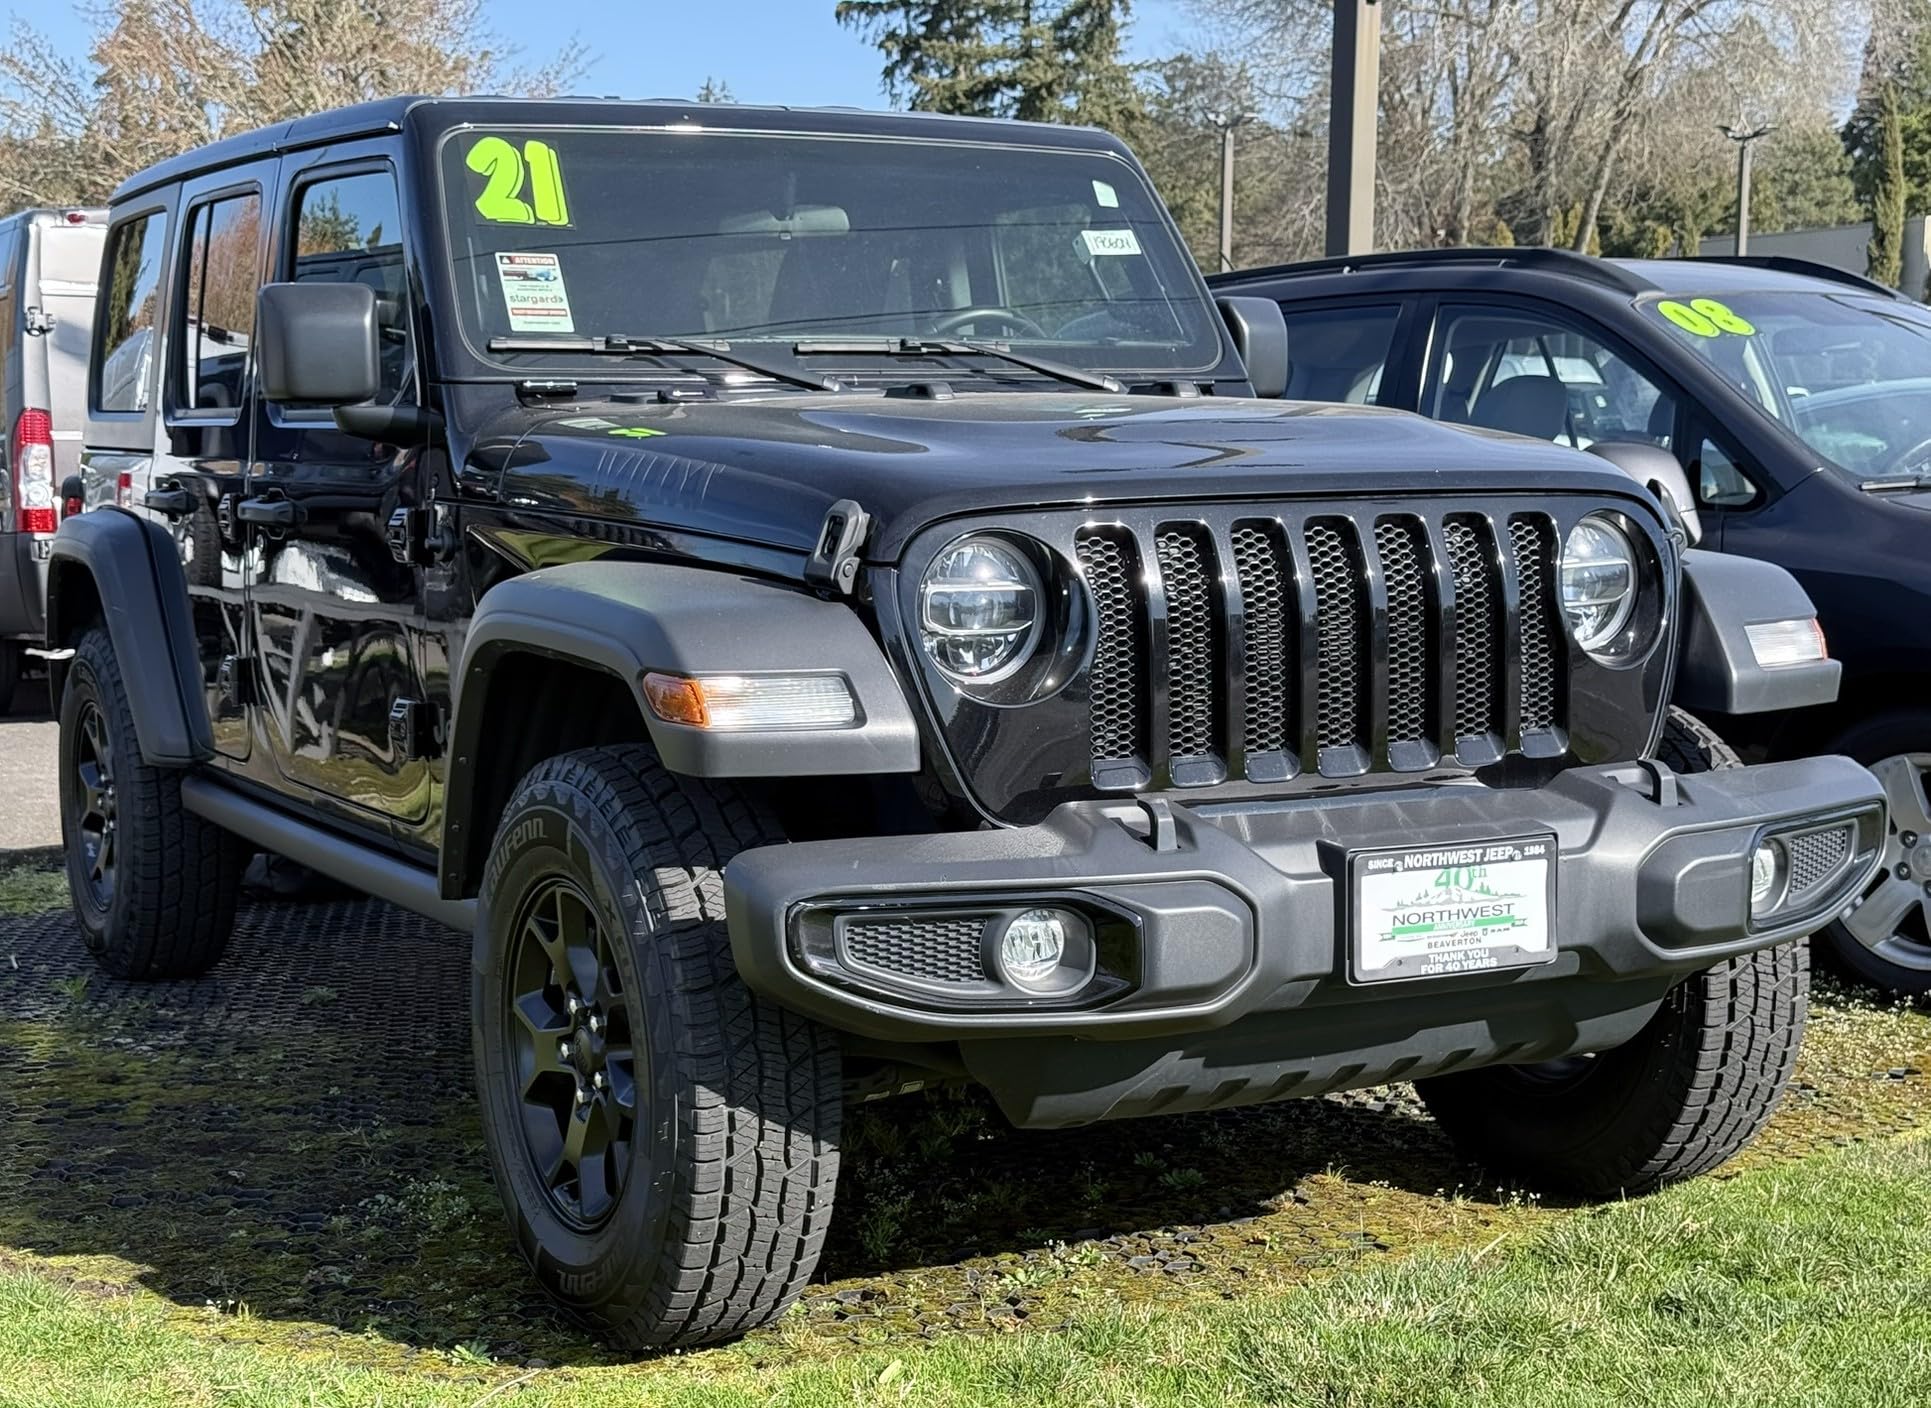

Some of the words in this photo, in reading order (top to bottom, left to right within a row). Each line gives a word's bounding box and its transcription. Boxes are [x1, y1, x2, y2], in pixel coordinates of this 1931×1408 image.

[466, 137, 569, 225] 21
[1657, 299, 1756, 338] 08
[1367, 858, 1394, 870] SINCE
[1404, 850, 1483, 868] NORTHWEST
[1484, 846, 1513, 861] JEEP
[1434, 866, 1487, 891] 40th
[1392, 903, 1515, 926] NORTHWEST
[1427, 937, 1482, 949] BEAVERTON
[1421, 963, 1443, 974] FOR
[1445, 961, 1460, 972] 40
[1461, 957, 1498, 970] YEARS
[1429, 951, 1466, 963] THANK
[1468, 948, 1489, 959] YOU
